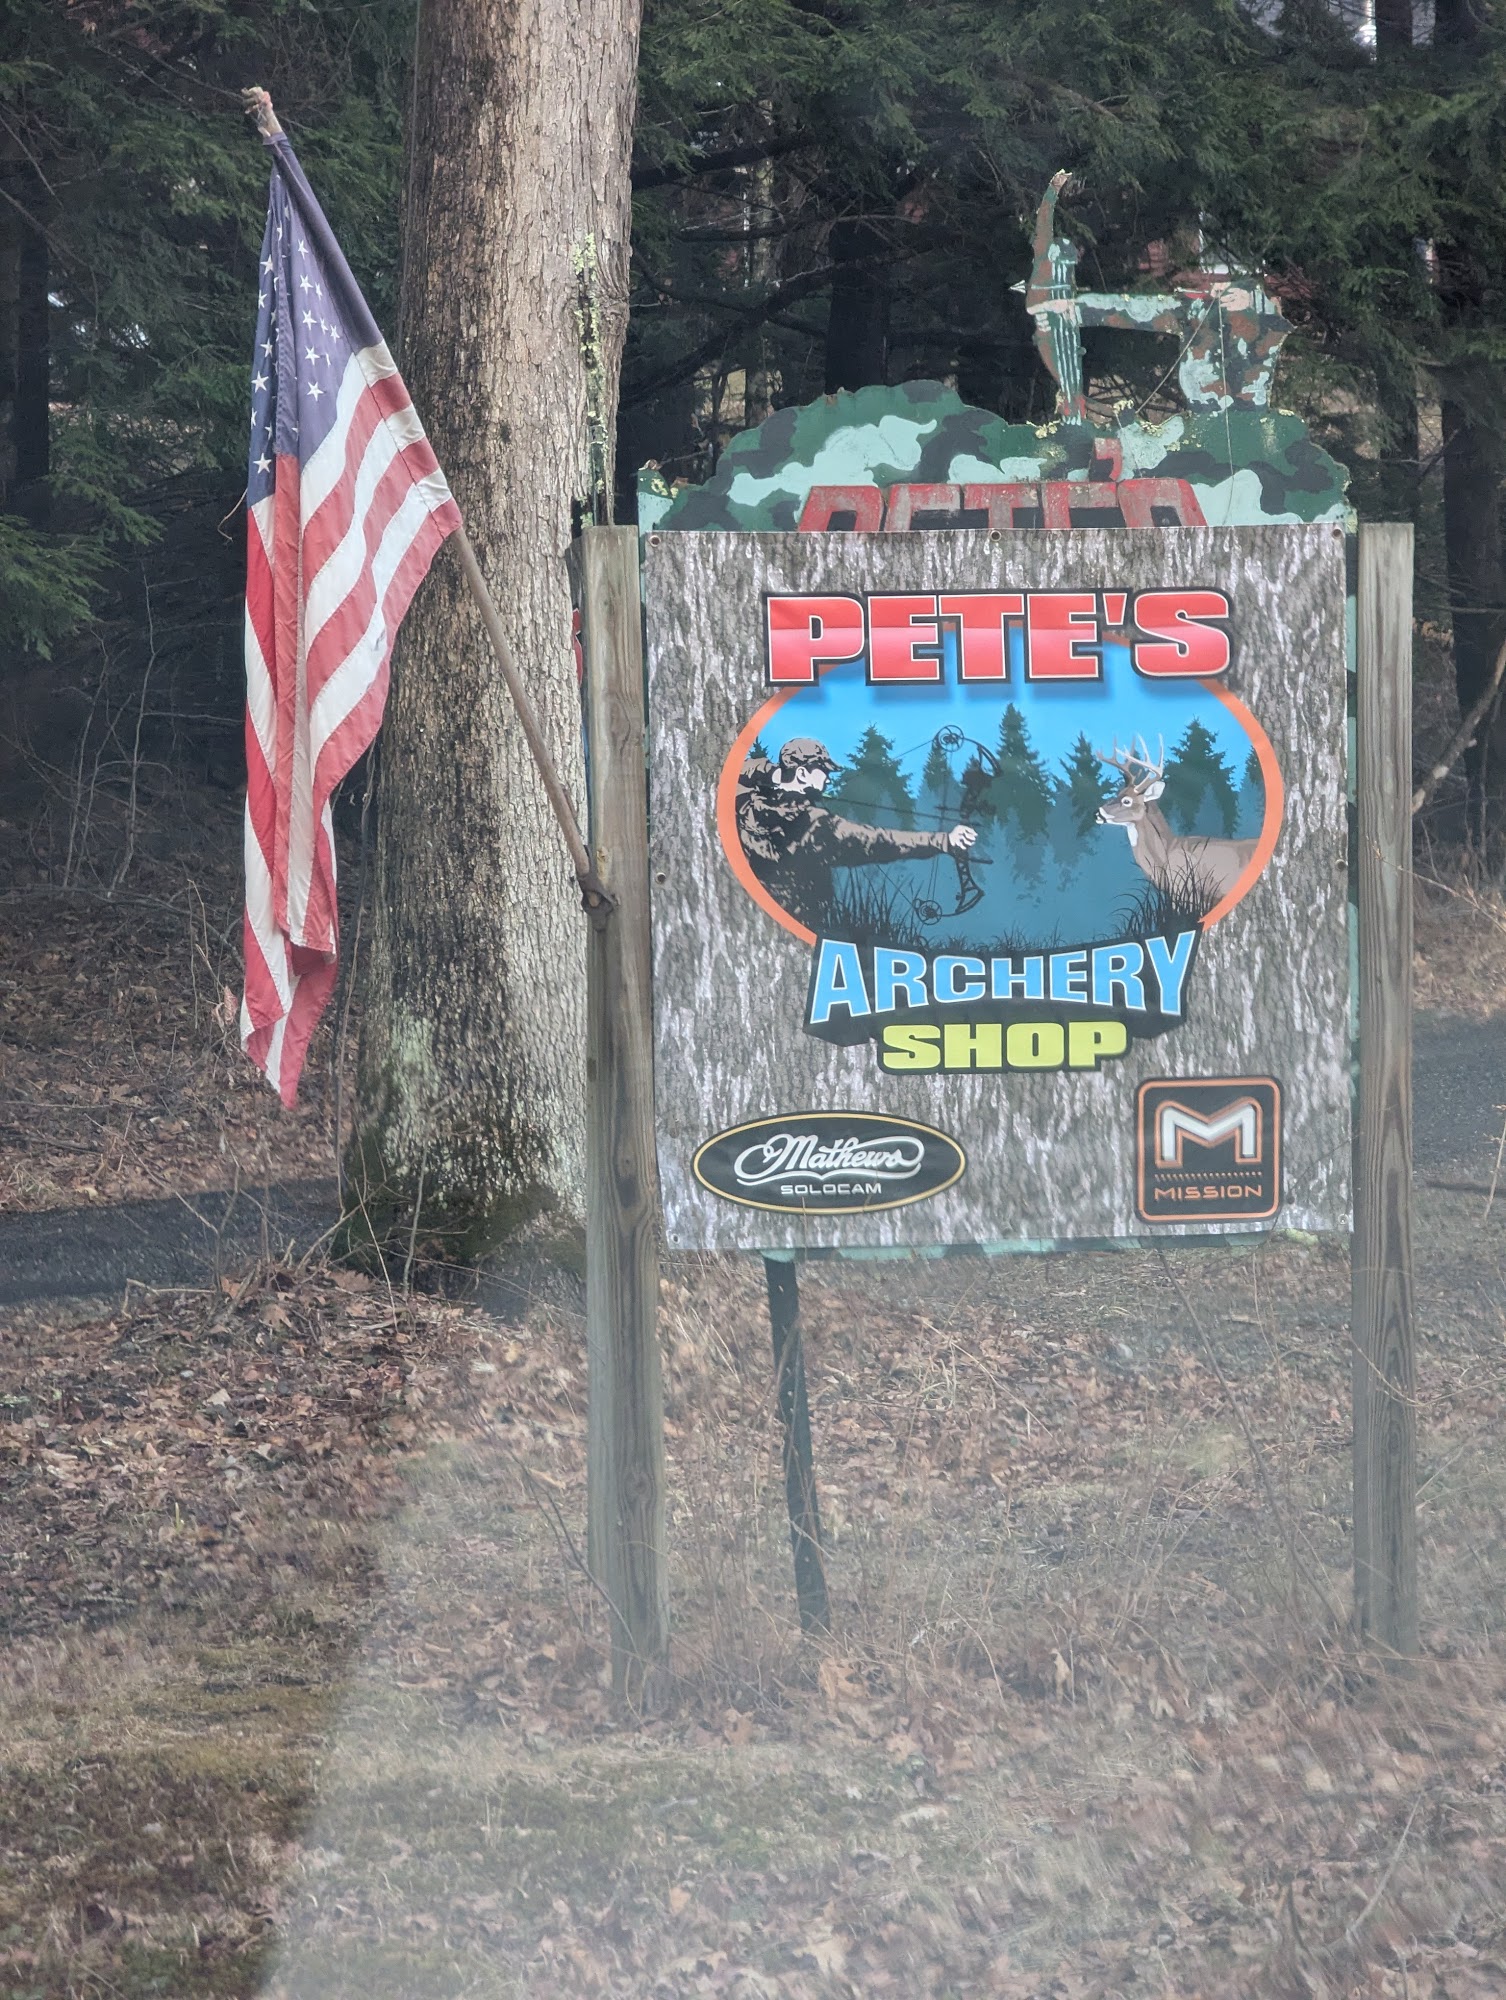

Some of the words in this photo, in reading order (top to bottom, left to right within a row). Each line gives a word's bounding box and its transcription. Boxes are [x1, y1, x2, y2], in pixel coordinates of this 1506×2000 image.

[765, 589, 1232, 684] PETE'S
[809, 929, 1197, 1025] ARCHERY
[882, 1020, 1127, 1070] SHOP
[734, 1133, 925, 1180] Mathews
[780, 1182, 882, 1195] SOLOCAM
[1154, 1184, 1262, 1201] MISSION
